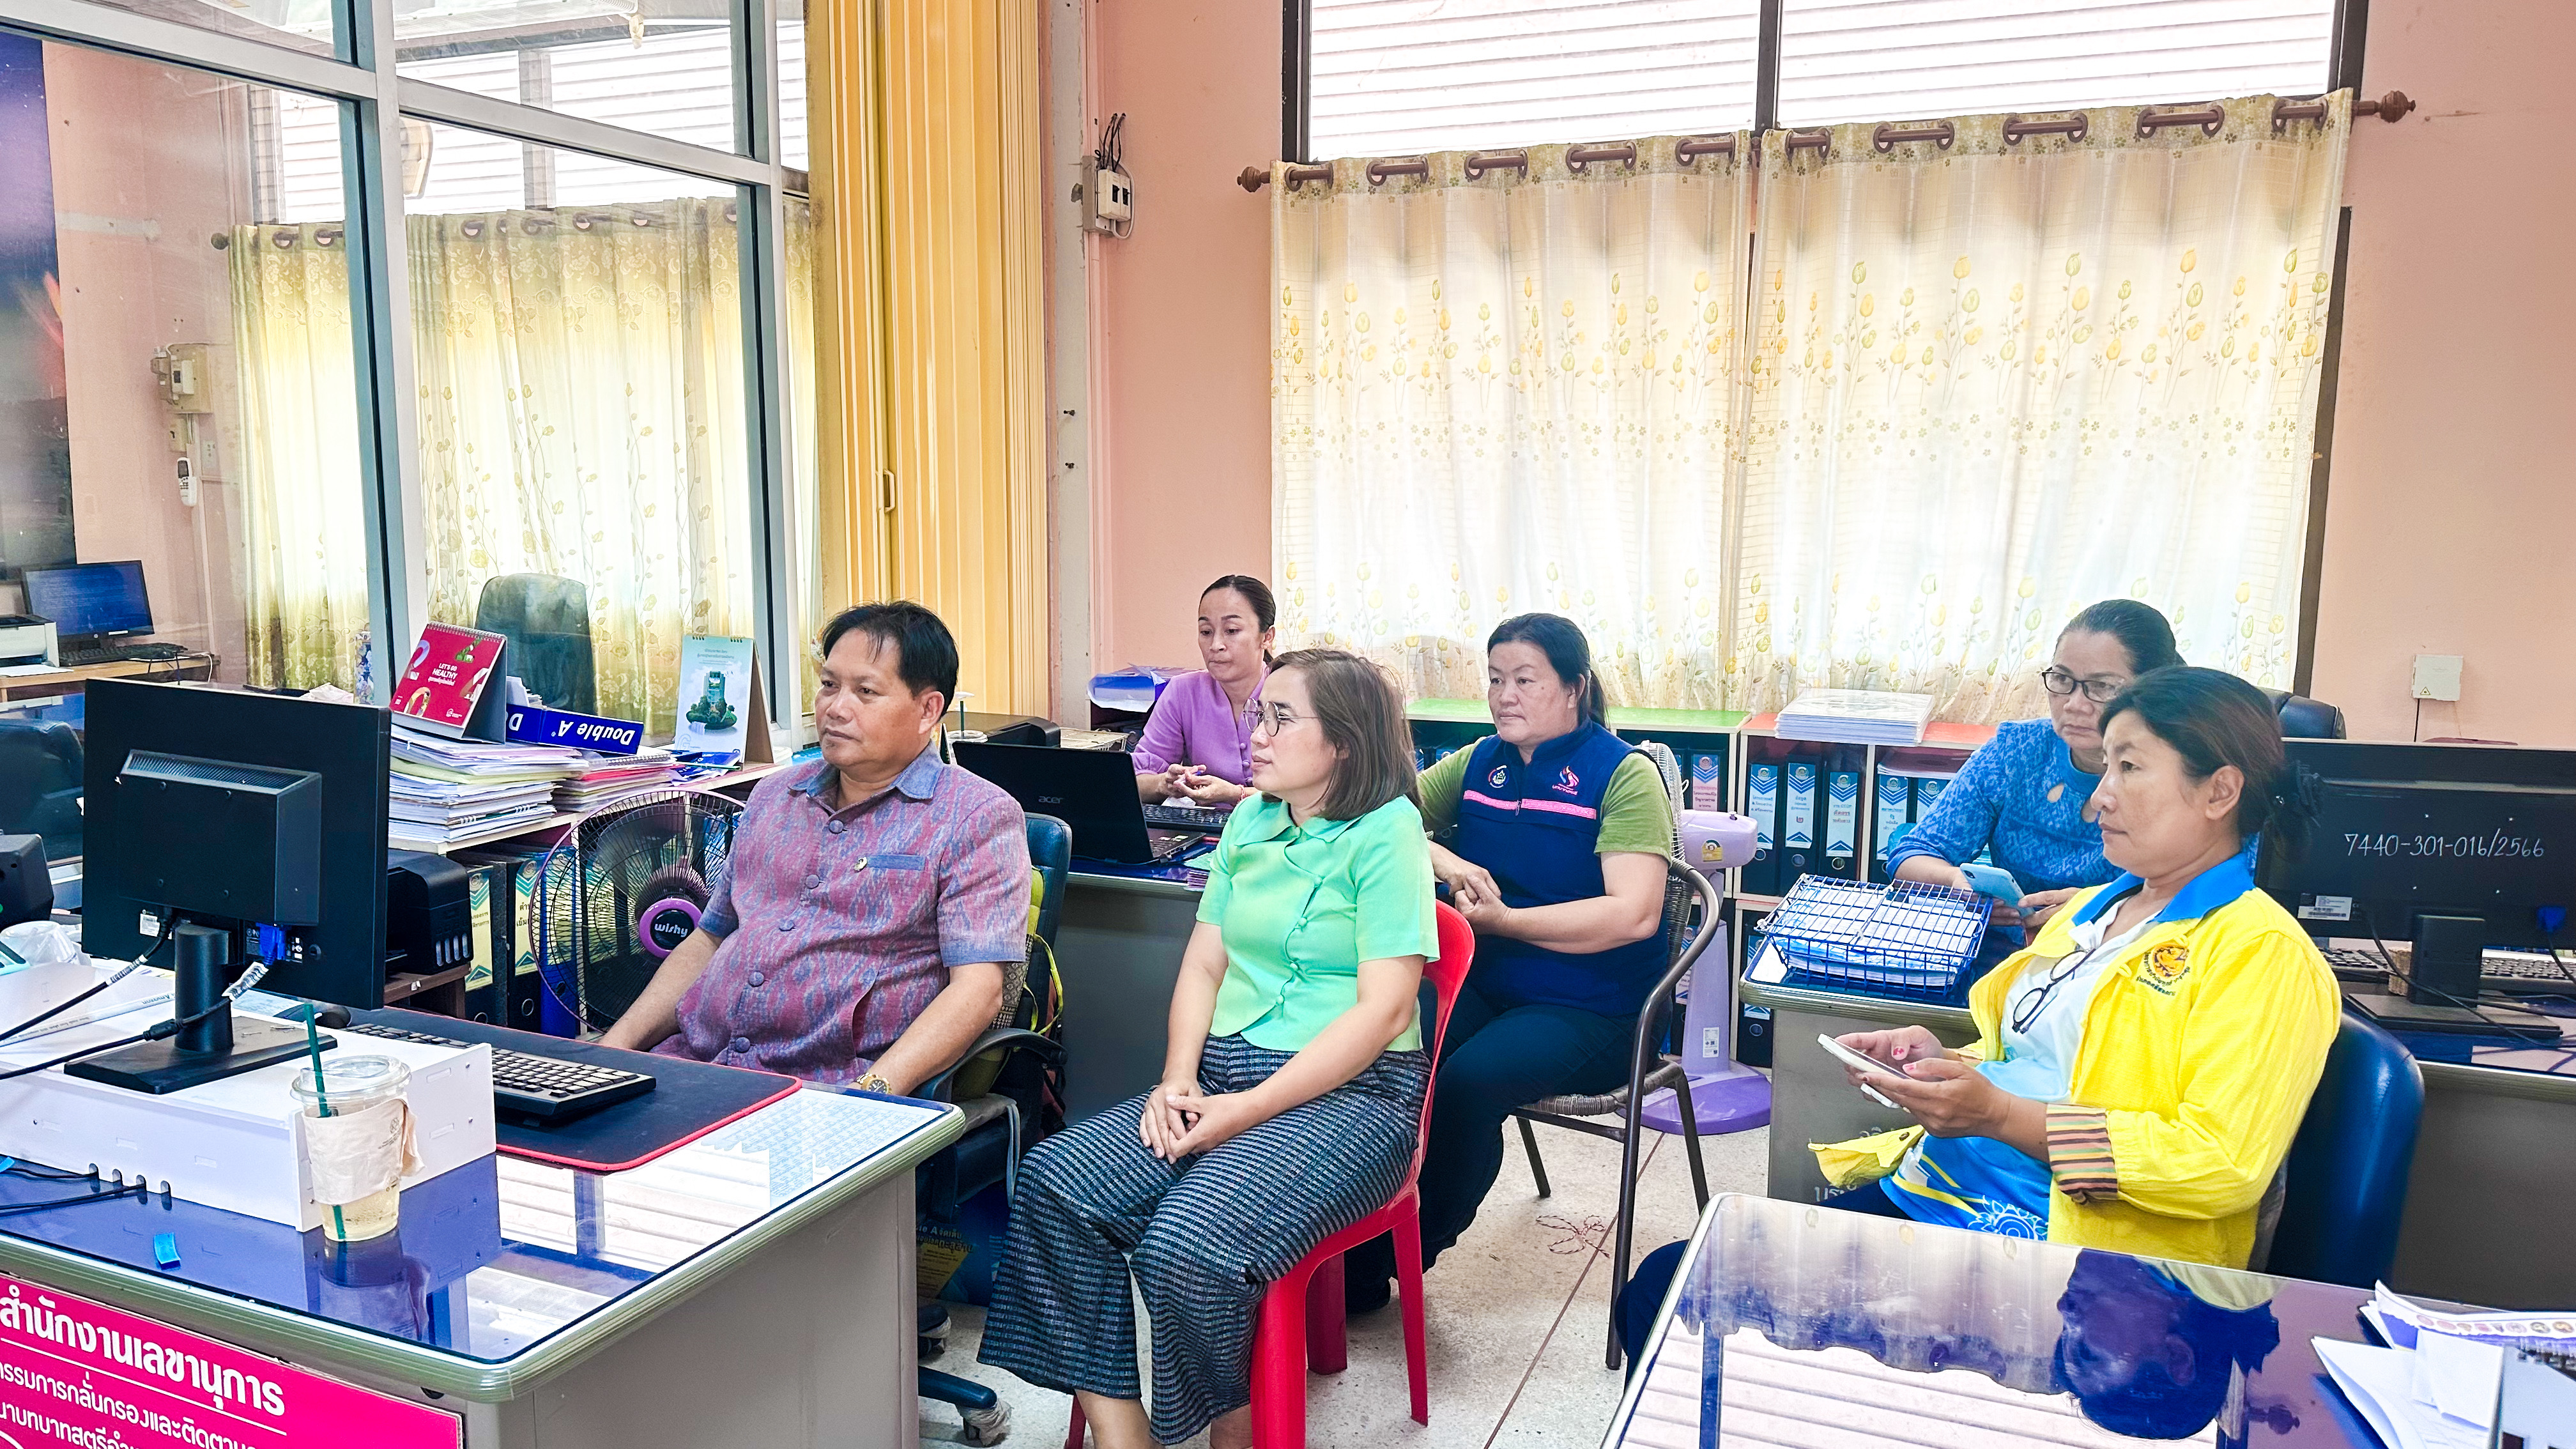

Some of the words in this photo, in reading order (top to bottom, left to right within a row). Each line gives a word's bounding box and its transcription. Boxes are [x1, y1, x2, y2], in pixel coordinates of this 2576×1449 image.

[432, 668, 458, 679] HEALTHY
[576, 723, 636, 746] Double
[1038, 795, 1064, 804] acer
[2344, 828, 2545, 857] 7440-301-016/2566
[0, 1284, 286, 1416] สำนักงานเลขานุการ
